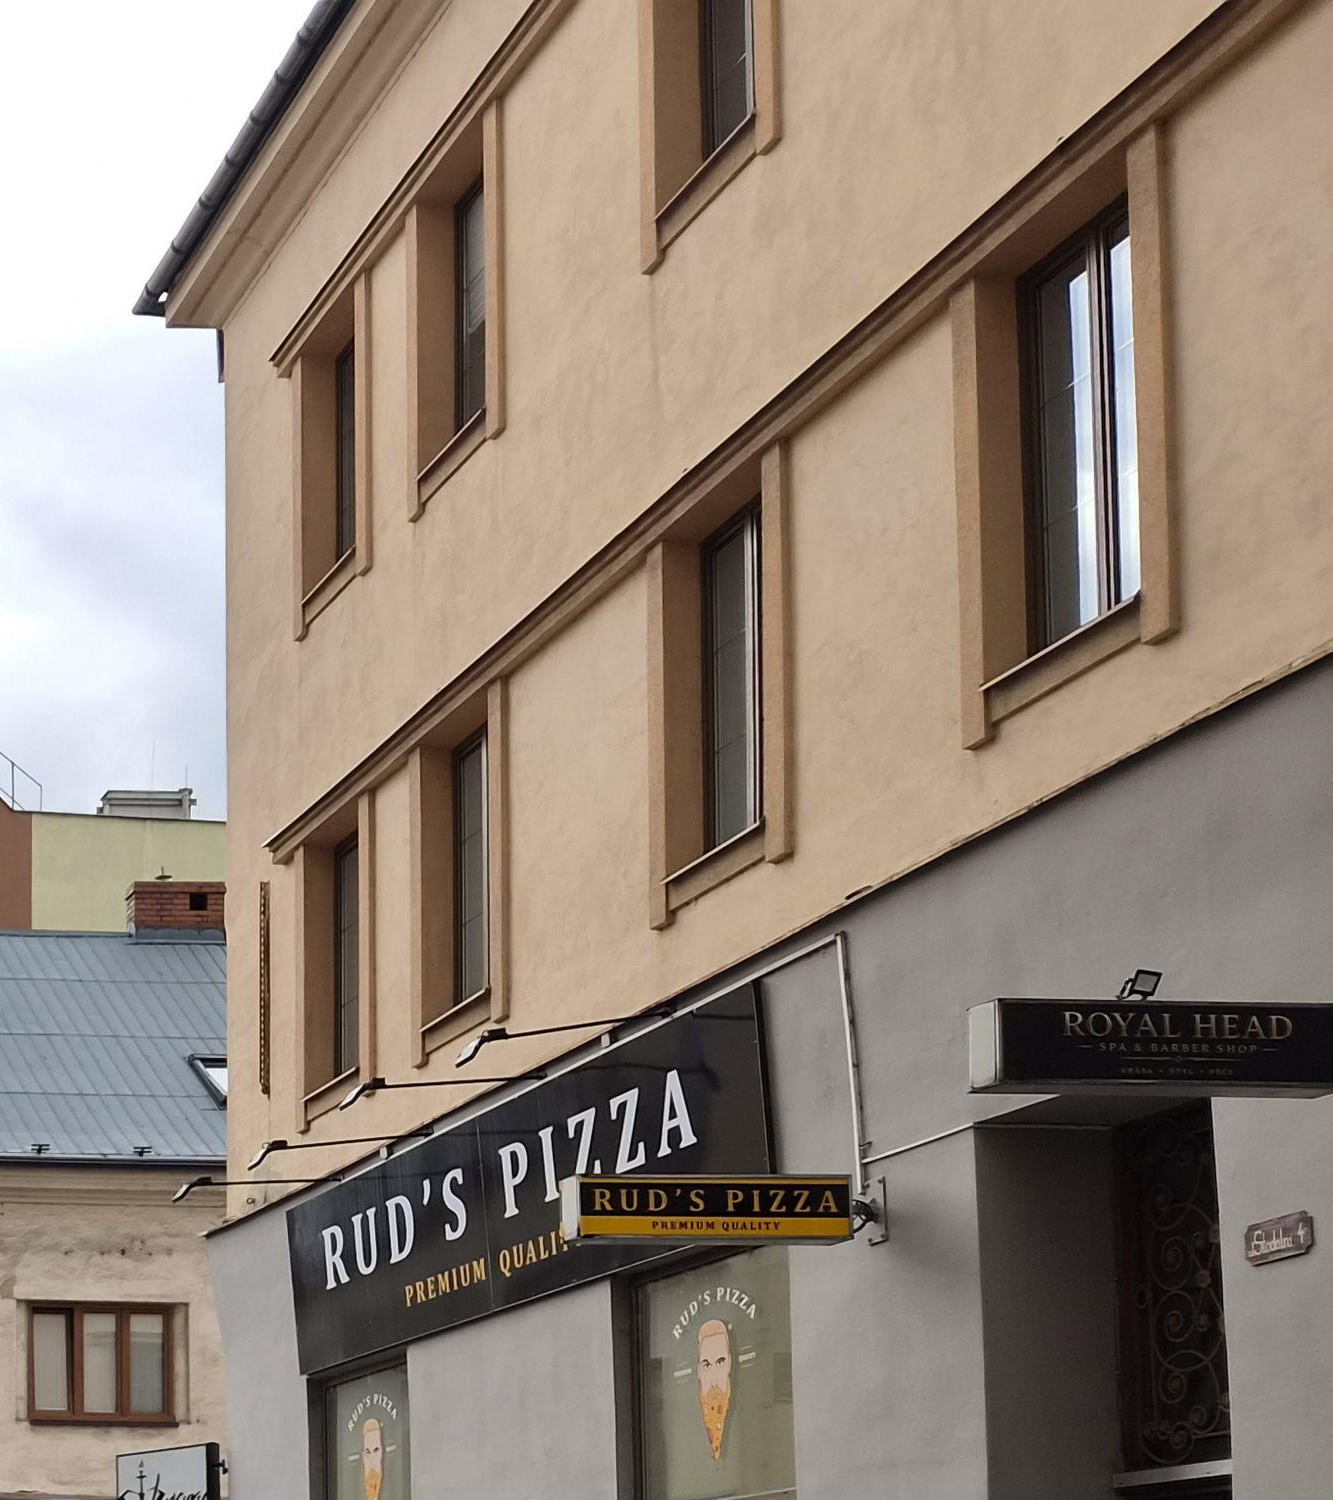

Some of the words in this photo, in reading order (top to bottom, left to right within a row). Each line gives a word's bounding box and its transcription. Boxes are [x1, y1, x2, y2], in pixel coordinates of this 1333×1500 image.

[1062, 1011, 1181, 1038] ROYAL
[1193, 1013, 1293, 1040] HEAD
[1099, 1042, 1127, 1052] SPA
[1134, 1043, 1142, 1052] &
[1151, 1042, 1210, 1054] BARBER
[1217, 1044, 1258, 1055] SHOP
[321, 1167, 468, 1290] RUD'S
[498, 1069, 698, 1218] PIZZA
[593, 1188, 706, 1212] RUD'S
[726, 1189, 839, 1213] PIZZA
[651, 1220, 716, 1231] PREMIUM
[721, 1221, 782, 1233] QUALITY
[1297, 1222, 1306, 1244] 4
[404, 1257, 488, 1308] PREMIUM
[672, 1290, 711, 1340] RUD'S
[716, 1286, 757, 1320] PIZZA
[373, 1393, 397, 1420] PIZZA
